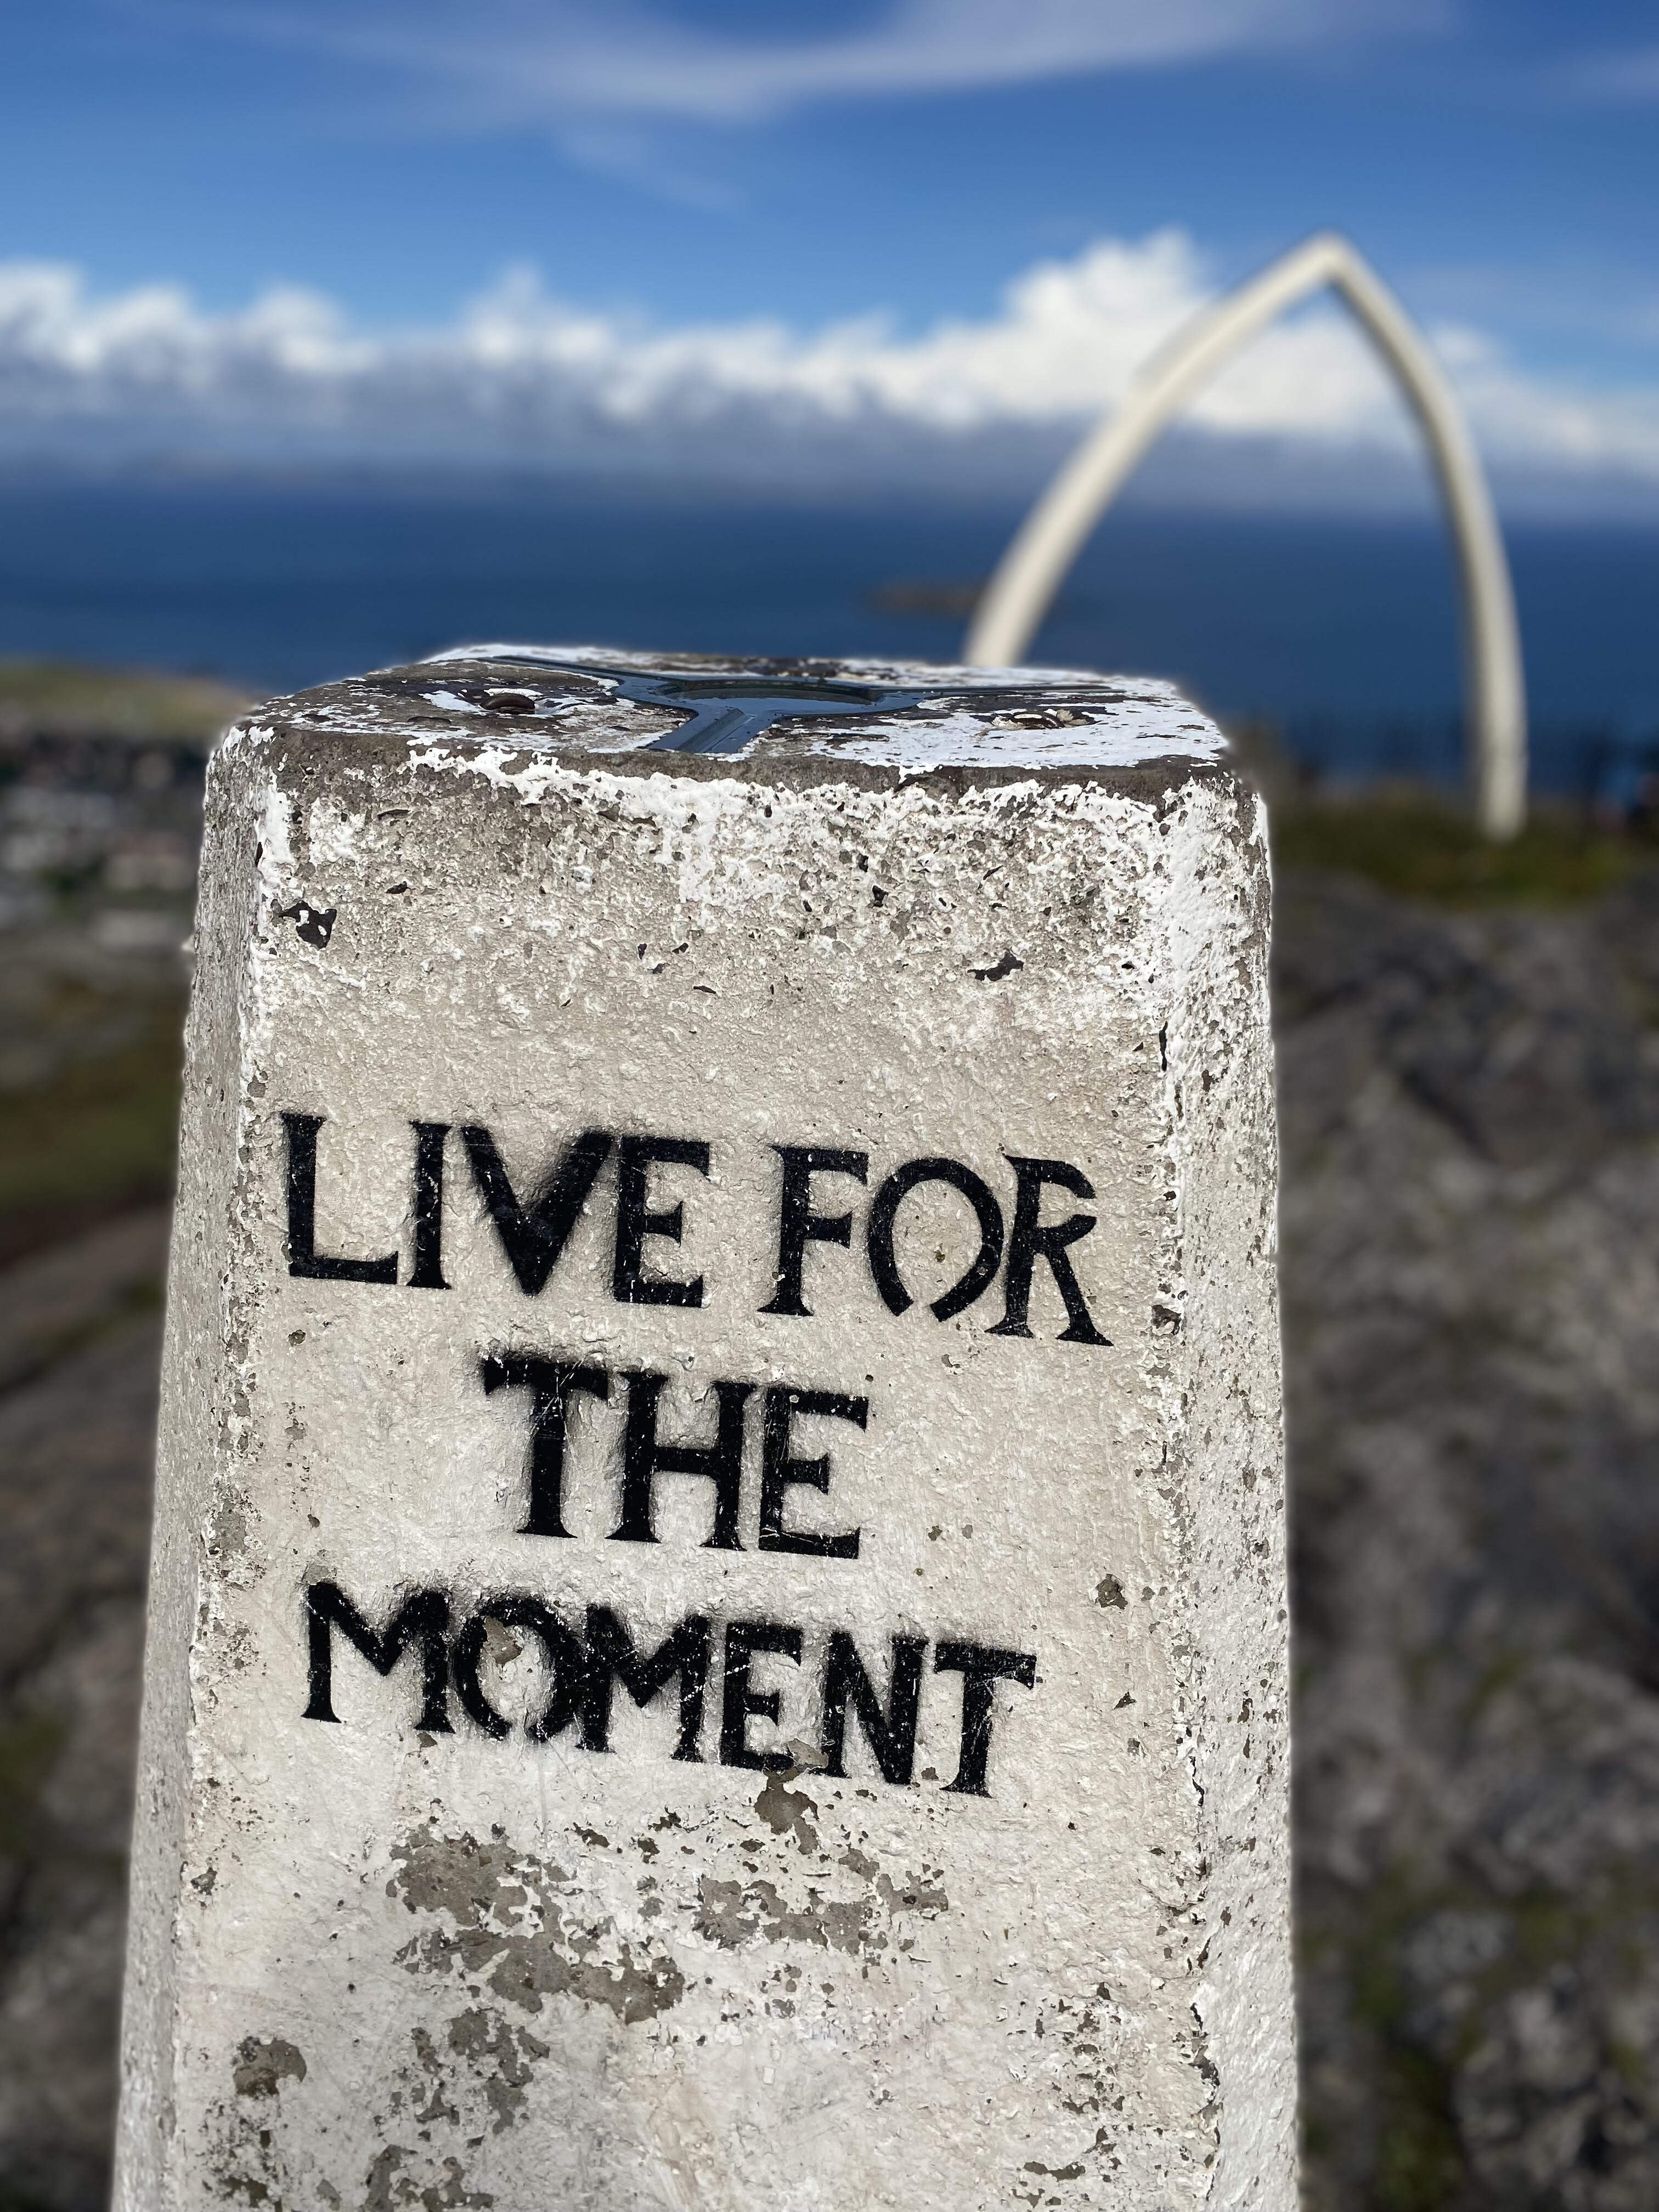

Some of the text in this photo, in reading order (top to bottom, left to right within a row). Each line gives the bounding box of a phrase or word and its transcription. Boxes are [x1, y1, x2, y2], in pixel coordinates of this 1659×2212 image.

[281, 1111, 1114, 1346] LIVE FOR
[483, 1353, 868, 1559] THE
[301, 1581, 1036, 1798] MOMENT
